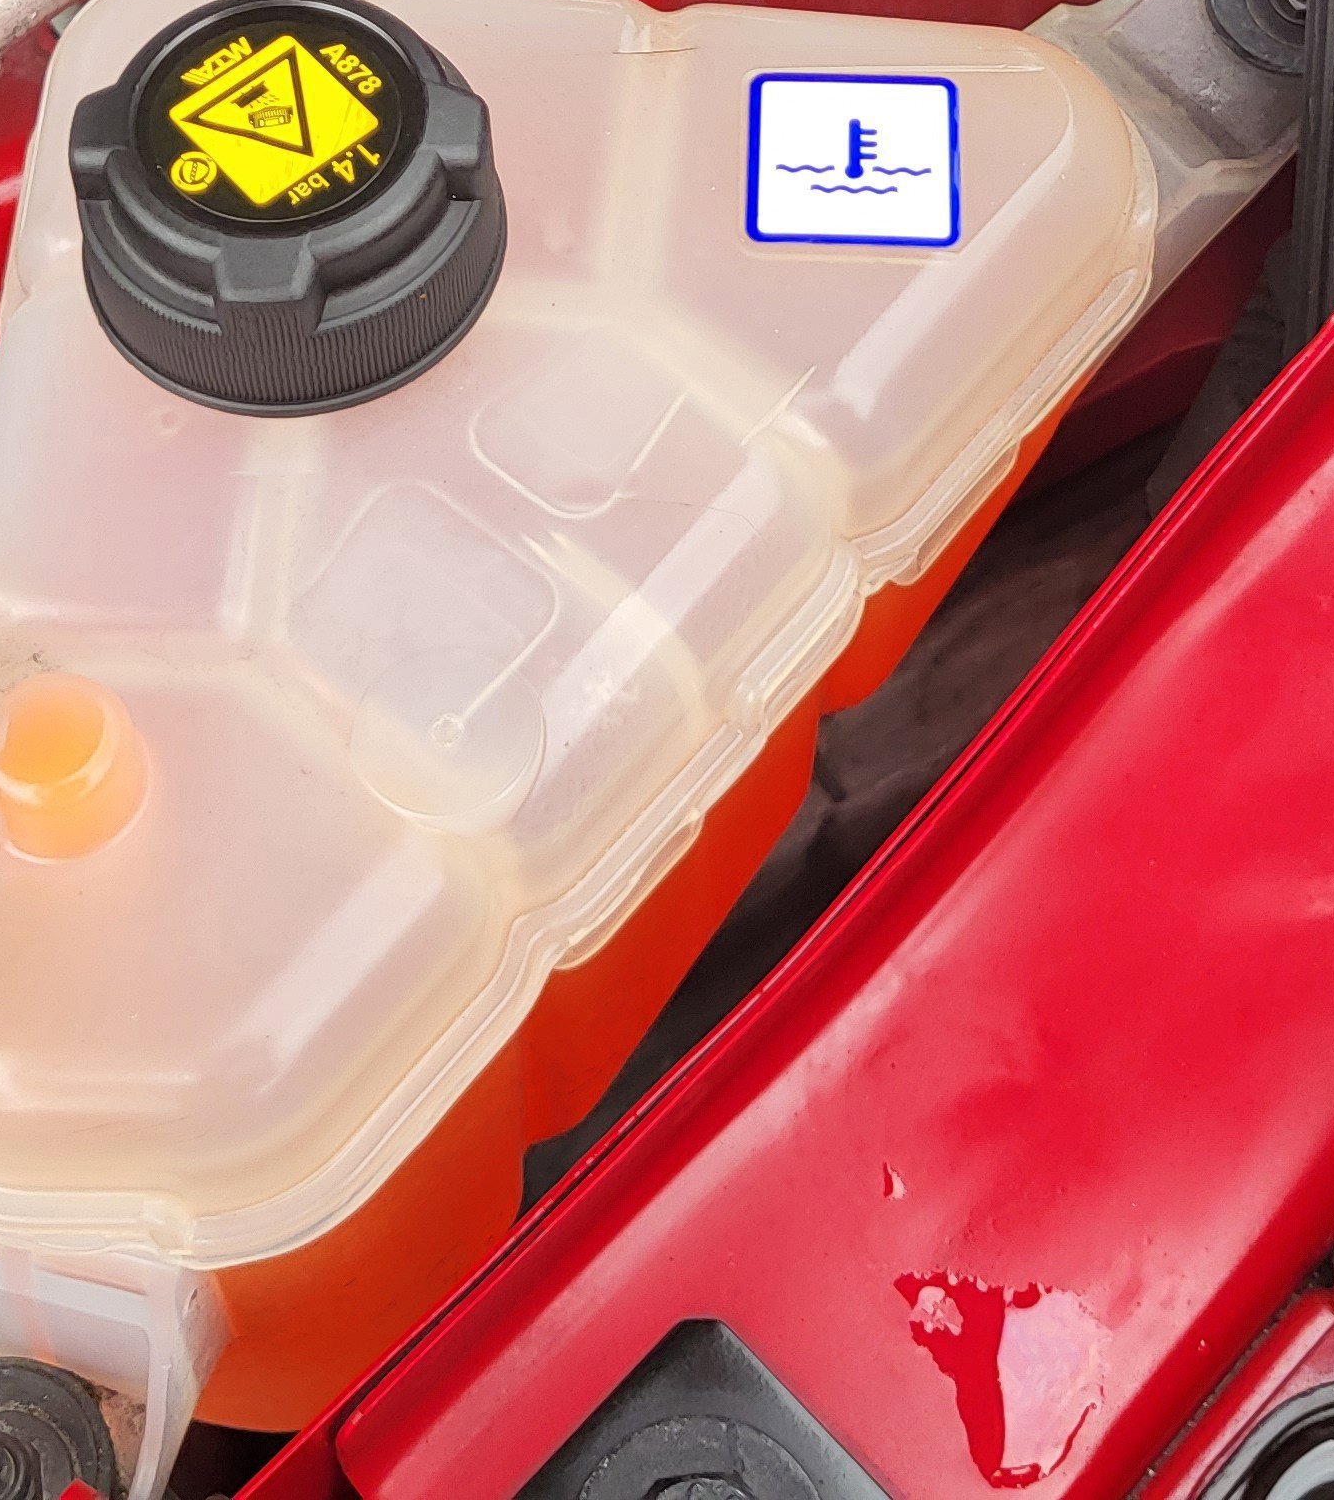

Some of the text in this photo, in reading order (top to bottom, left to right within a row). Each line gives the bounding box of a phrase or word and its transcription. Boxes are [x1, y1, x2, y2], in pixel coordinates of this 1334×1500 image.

[319, 43, 383, 95] A878
[287, 143, 381, 206] 1.4 bar
